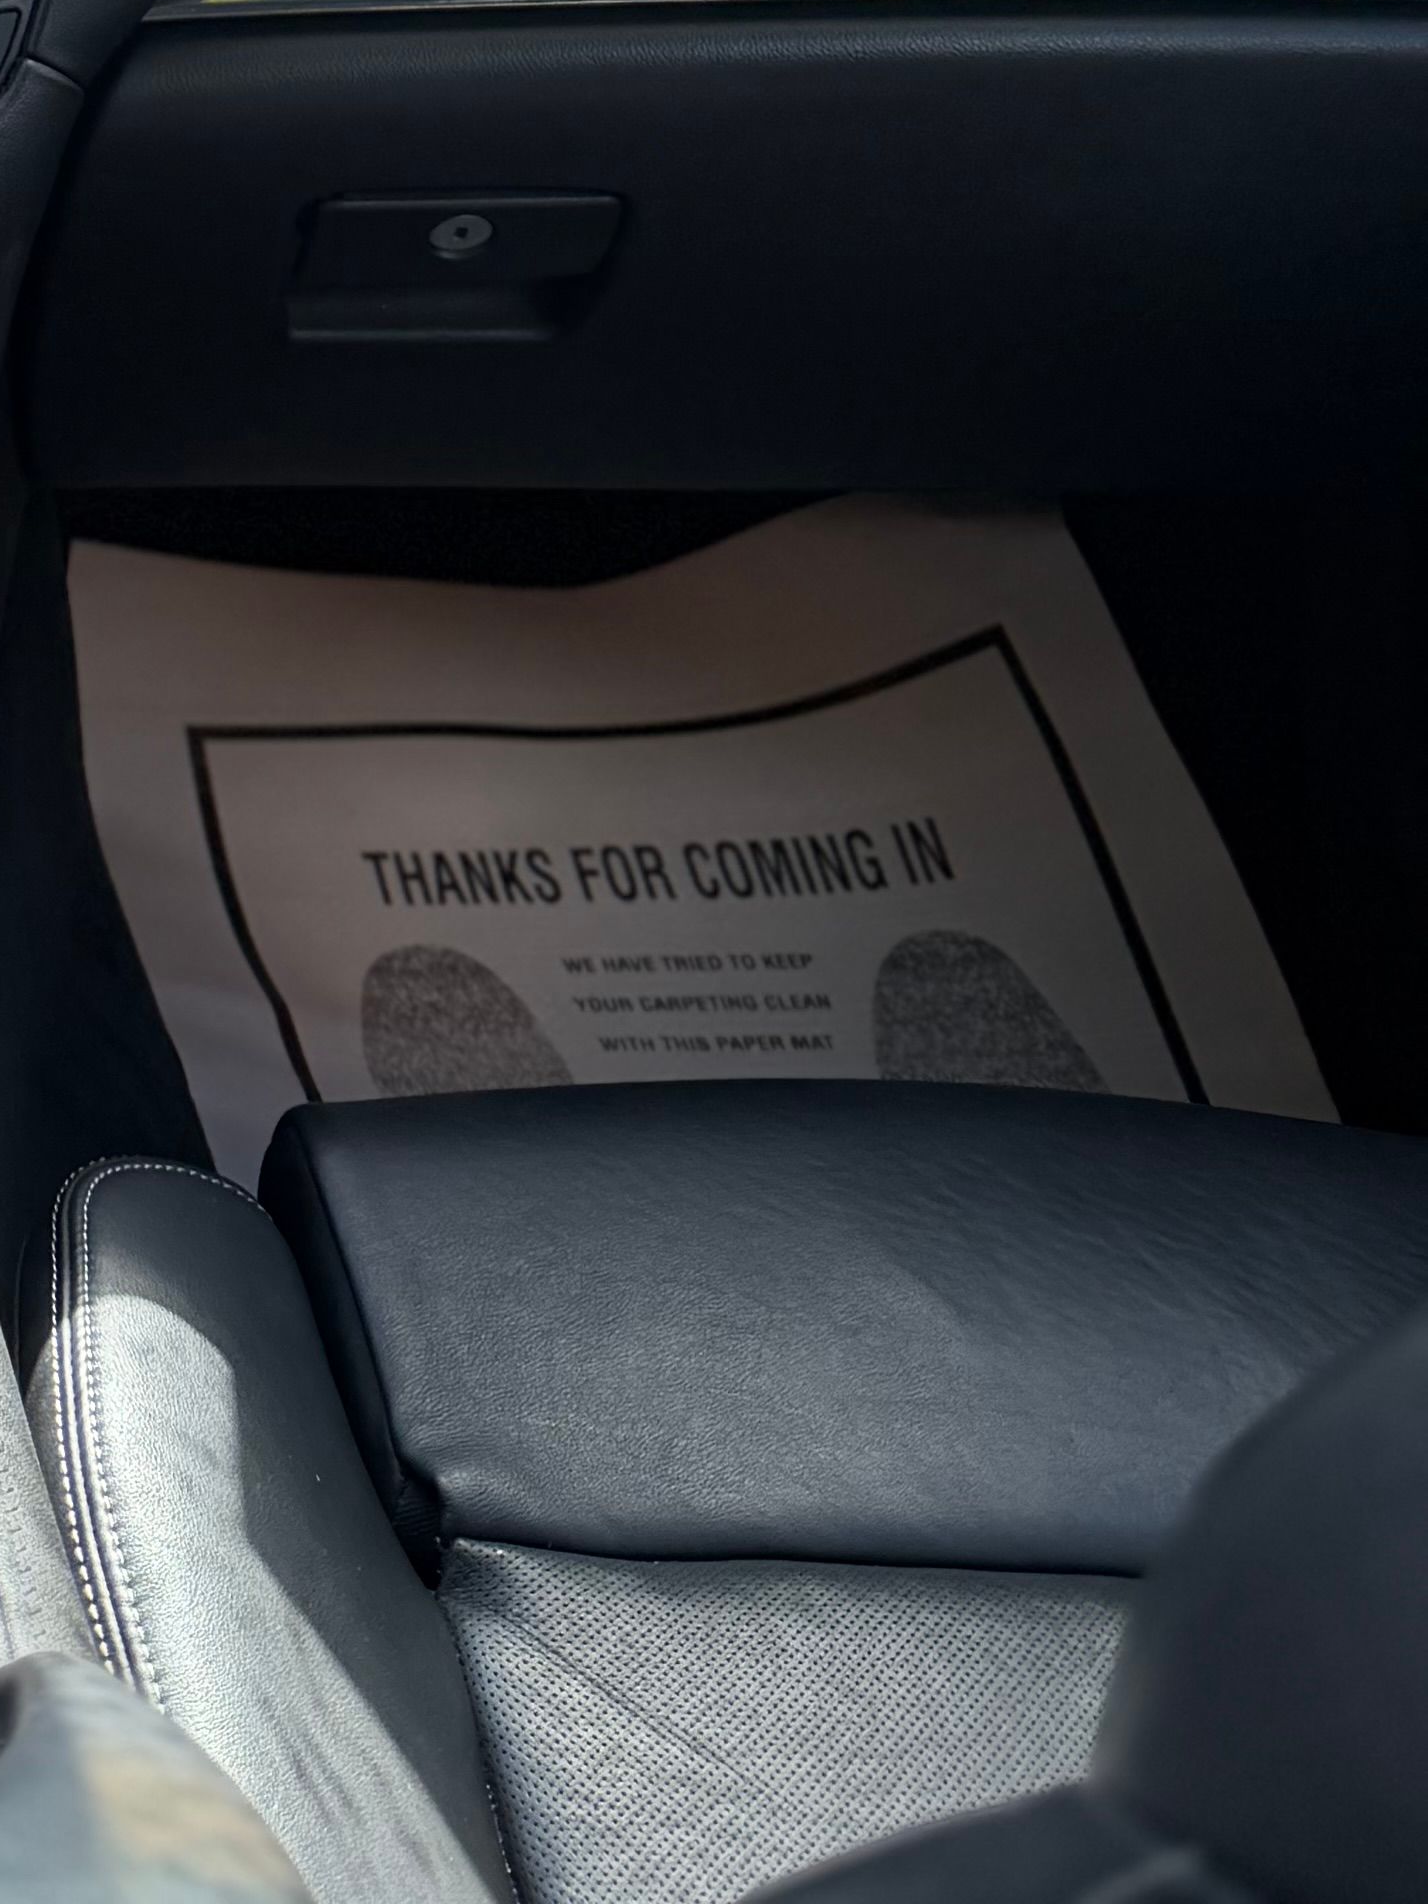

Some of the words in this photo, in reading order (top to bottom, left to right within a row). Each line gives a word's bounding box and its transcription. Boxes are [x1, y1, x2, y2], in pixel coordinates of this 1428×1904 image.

[361, 848, 562, 906] THANKS
[569, 841, 675, 902] FOR
[681, 827, 886, 900] COMING
[889, 816, 956, 885] IN
[562, 957, 596, 973] WE
[602, 956, 657, 972] HAVE
[661, 954, 722, 972] TRIED
[728, 954, 756, 971] TO
[762, 953, 813, 970] KEEP
[572, 996, 633, 1013] YOUR
[640, 995, 758, 1012] CARPETING
[764, 994, 832, 1011] CLEAN
[599, 1036, 655, 1052] WITH
[660, 1036, 711, 1052] THIS
[716, 1035, 785, 1051] PAPER
[790, 1034, 834, 1050] MAT
